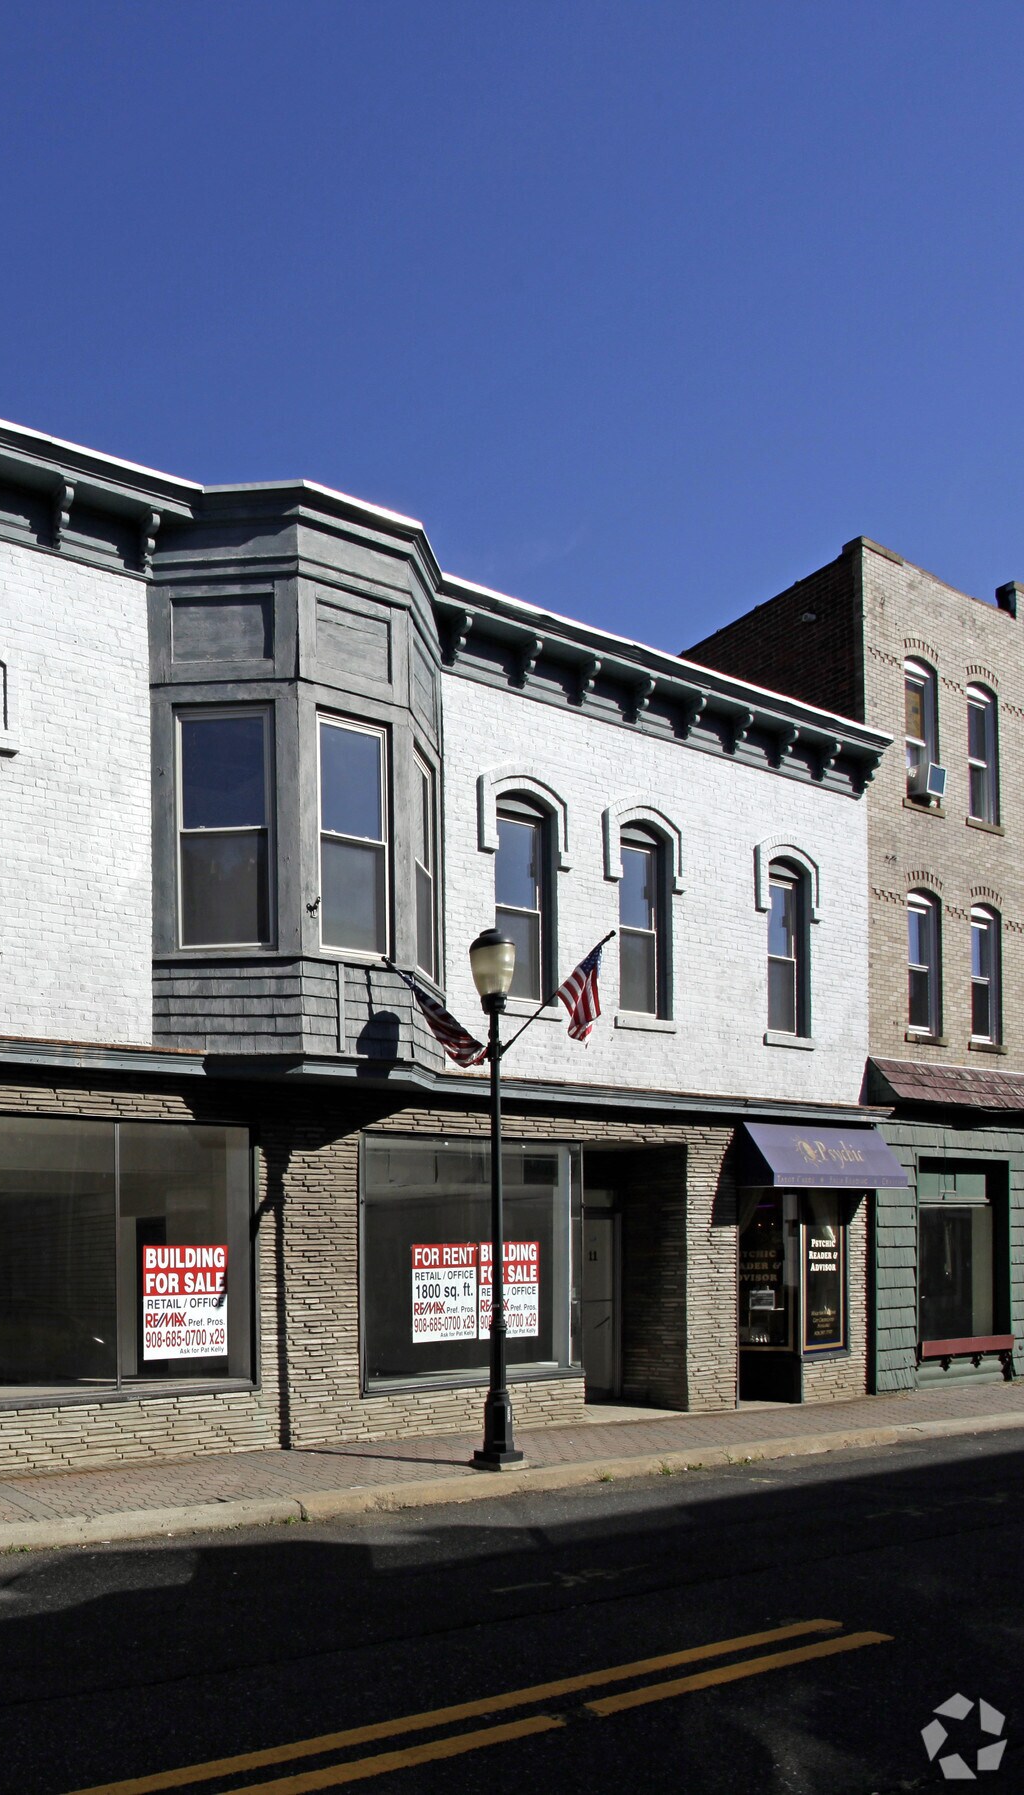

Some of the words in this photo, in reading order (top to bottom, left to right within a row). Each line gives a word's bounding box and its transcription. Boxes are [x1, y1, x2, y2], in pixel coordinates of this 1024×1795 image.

[813, 1140, 865, 1169] Psychic
[811, 1238, 836, 1248] PSYCHIC
[145, 1247, 225, 1269] BUILDING
[414, 1248, 439, 1266] FOR
[443, 1246, 474, 1265] RENT
[480, 1244, 537, 1262] BLDING
[589, 1250, 598, 1261] 11
[739, 1249, 777, 1258] YCHIC
[808, 1250, 832, 1260] READER
[832, 1251, 839, 1260] &
[772, 1261, 782, 1270] &
[810, 1262, 837, 1272] ADVISOR
[414, 1271, 441, 1281] RETAIL
[447, 1270, 474, 1280] OFFICE
[507, 1264, 537, 1283] SALE
[145, 1272, 179, 1294] FOR
[184, 1271, 225, 1293] SALE
[416, 1283, 441, 1299] 1800
[443, 1286, 460, 1301] sq.
[463, 1282, 473, 1296] ft.
[511, 1286, 536, 1295] OFFICE
[147, 1299, 181, 1309] RETAIL
[189, 1297, 224, 1308] OFFICE
[414, 1301, 446, 1315] RE/MAX
[145, 1312, 187, 1328] RE/MAX
[188, 1318, 205, 1327] Pref.
[207, 1317, 225, 1326] Pros.
[414, 1315, 461, 1333] 908-685-0700
[463, 1314, 475, 1329] x29
[525, 1312, 537, 1327] x29
[145, 1329, 207, 1348] 908-685-0700
[209, 1328, 225, 1345] x29
[211, 1345, 224, 1353] Kelly
